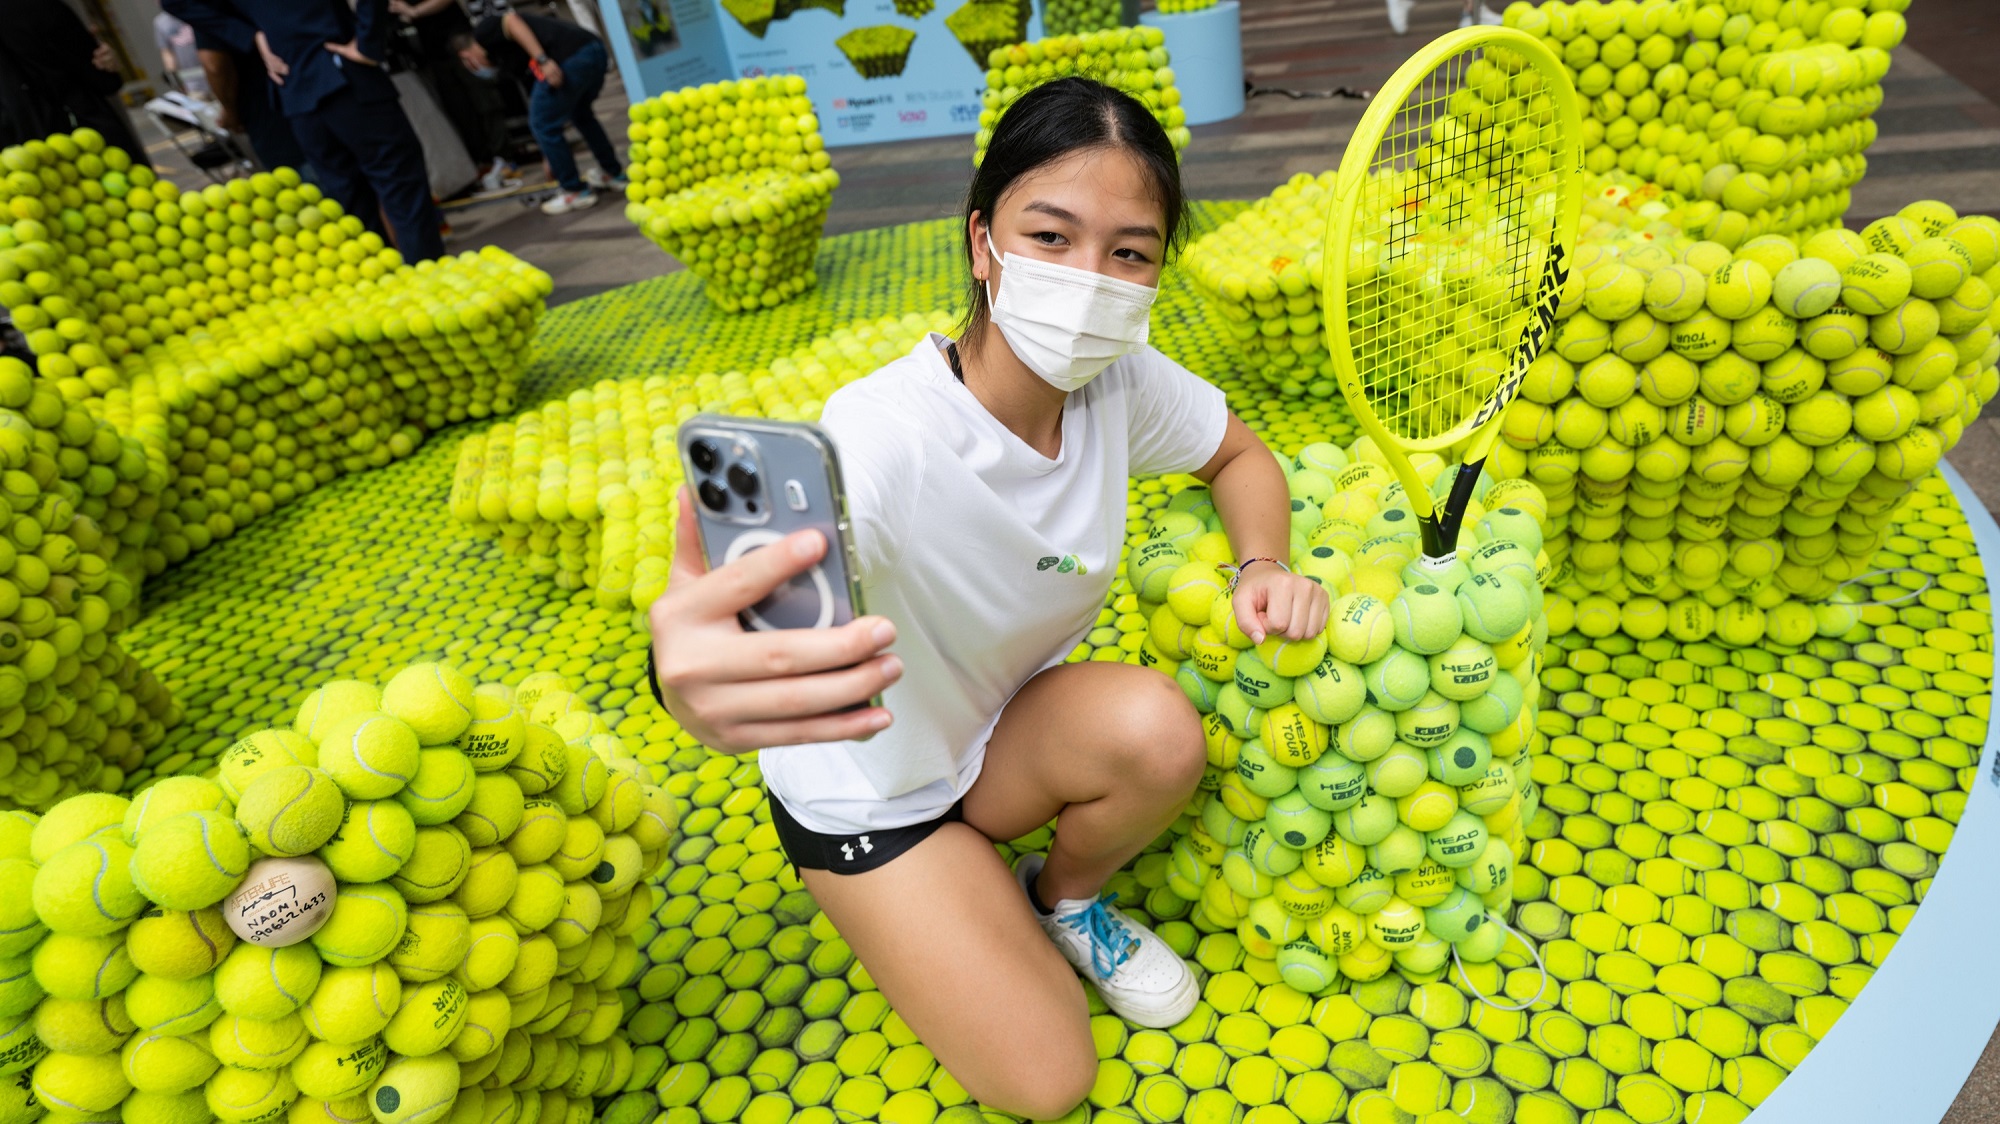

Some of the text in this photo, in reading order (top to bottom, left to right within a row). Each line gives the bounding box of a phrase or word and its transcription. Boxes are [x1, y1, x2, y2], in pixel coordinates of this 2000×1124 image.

[1340, 470, 1371, 491] TOUR
[1441, 657, 1495, 673] HEAD
[464, 738, 510, 752] FORT
[468, 734, 497, 742] ELITE
[1281, 724, 1301, 758] TOUR
[1293, 712, 1312, 761] HEAD
[1320, 771, 1366, 791] HEAD
[1430, 829, 1480, 846] HEAD
[230, 872, 292, 912] AFTERLIFE
[1374, 922, 1422, 936] HEAD
